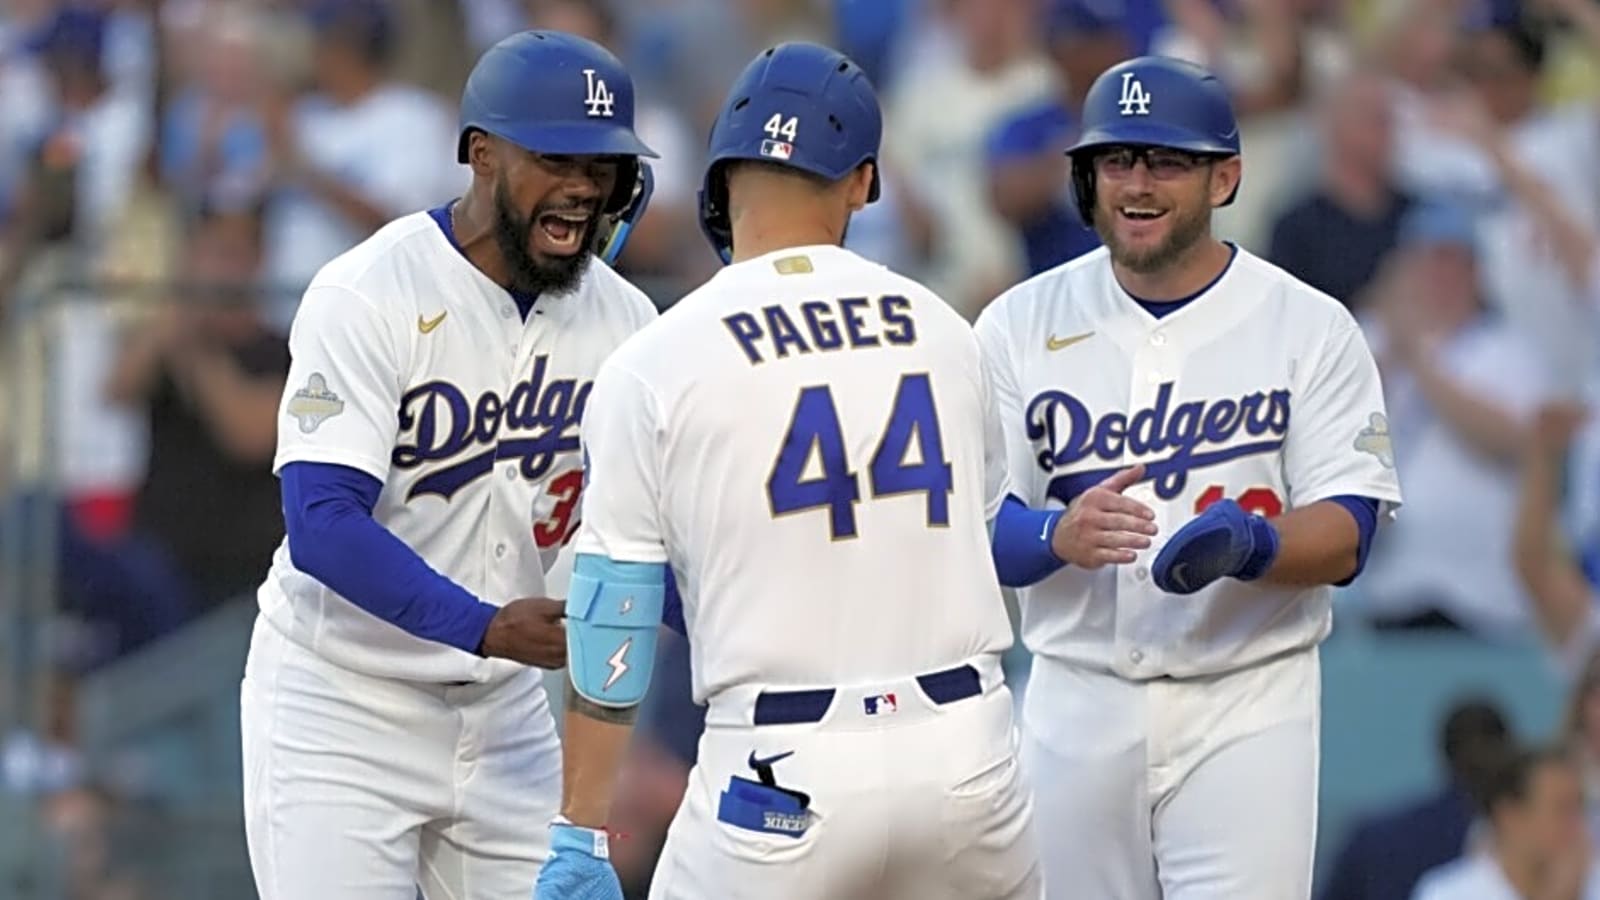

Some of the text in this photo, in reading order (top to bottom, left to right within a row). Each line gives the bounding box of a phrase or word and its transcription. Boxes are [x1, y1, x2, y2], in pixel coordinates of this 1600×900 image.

[582, 69, 614, 117] LA
[764, 113, 798, 142] 44
[1118, 72, 1151, 115] LA
[721, 294, 918, 366] PAGES
[765, 372, 954, 542] 44
[1025, 381, 1292, 501] Dodgers
[533, 469, 584, 549] 3
